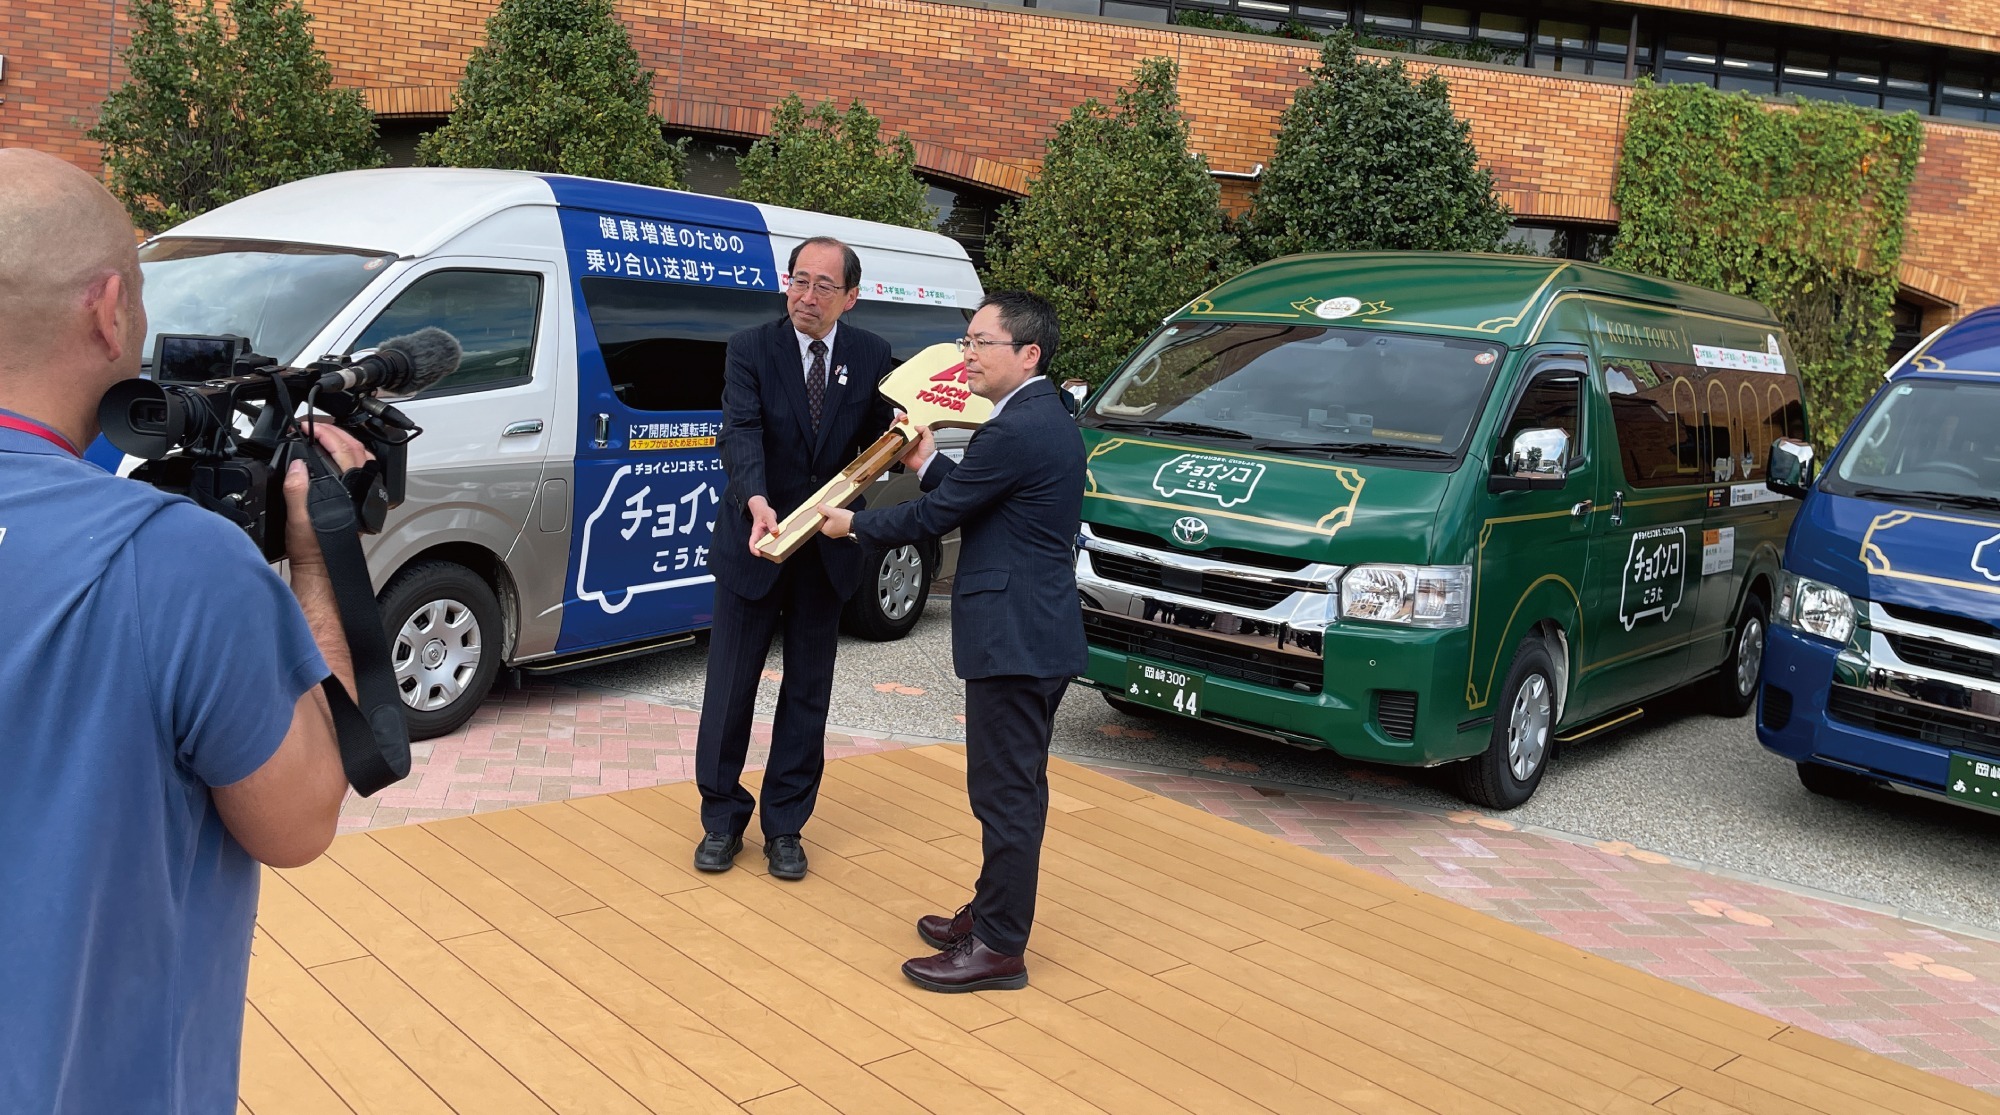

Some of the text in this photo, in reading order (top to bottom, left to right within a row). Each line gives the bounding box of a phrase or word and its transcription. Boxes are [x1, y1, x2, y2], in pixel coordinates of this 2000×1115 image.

[599, 215, 744, 254] 健康増進のための
[585, 248, 766, 287] 乗り合い送迎サービス
[1606, 321, 1680, 350] KOTA TOWN
[916, 389, 966, 413] TOYOTA
[930, 383, 972, 401] AICHI
[1175, 459, 1252, 483] チョイソコ
[1186, 479, 1218, 492] こうた
[652, 545, 710, 573] こうた
[1634, 542, 1680, 584] チョイソコ
[1643, 586, 1664, 605] こうた
